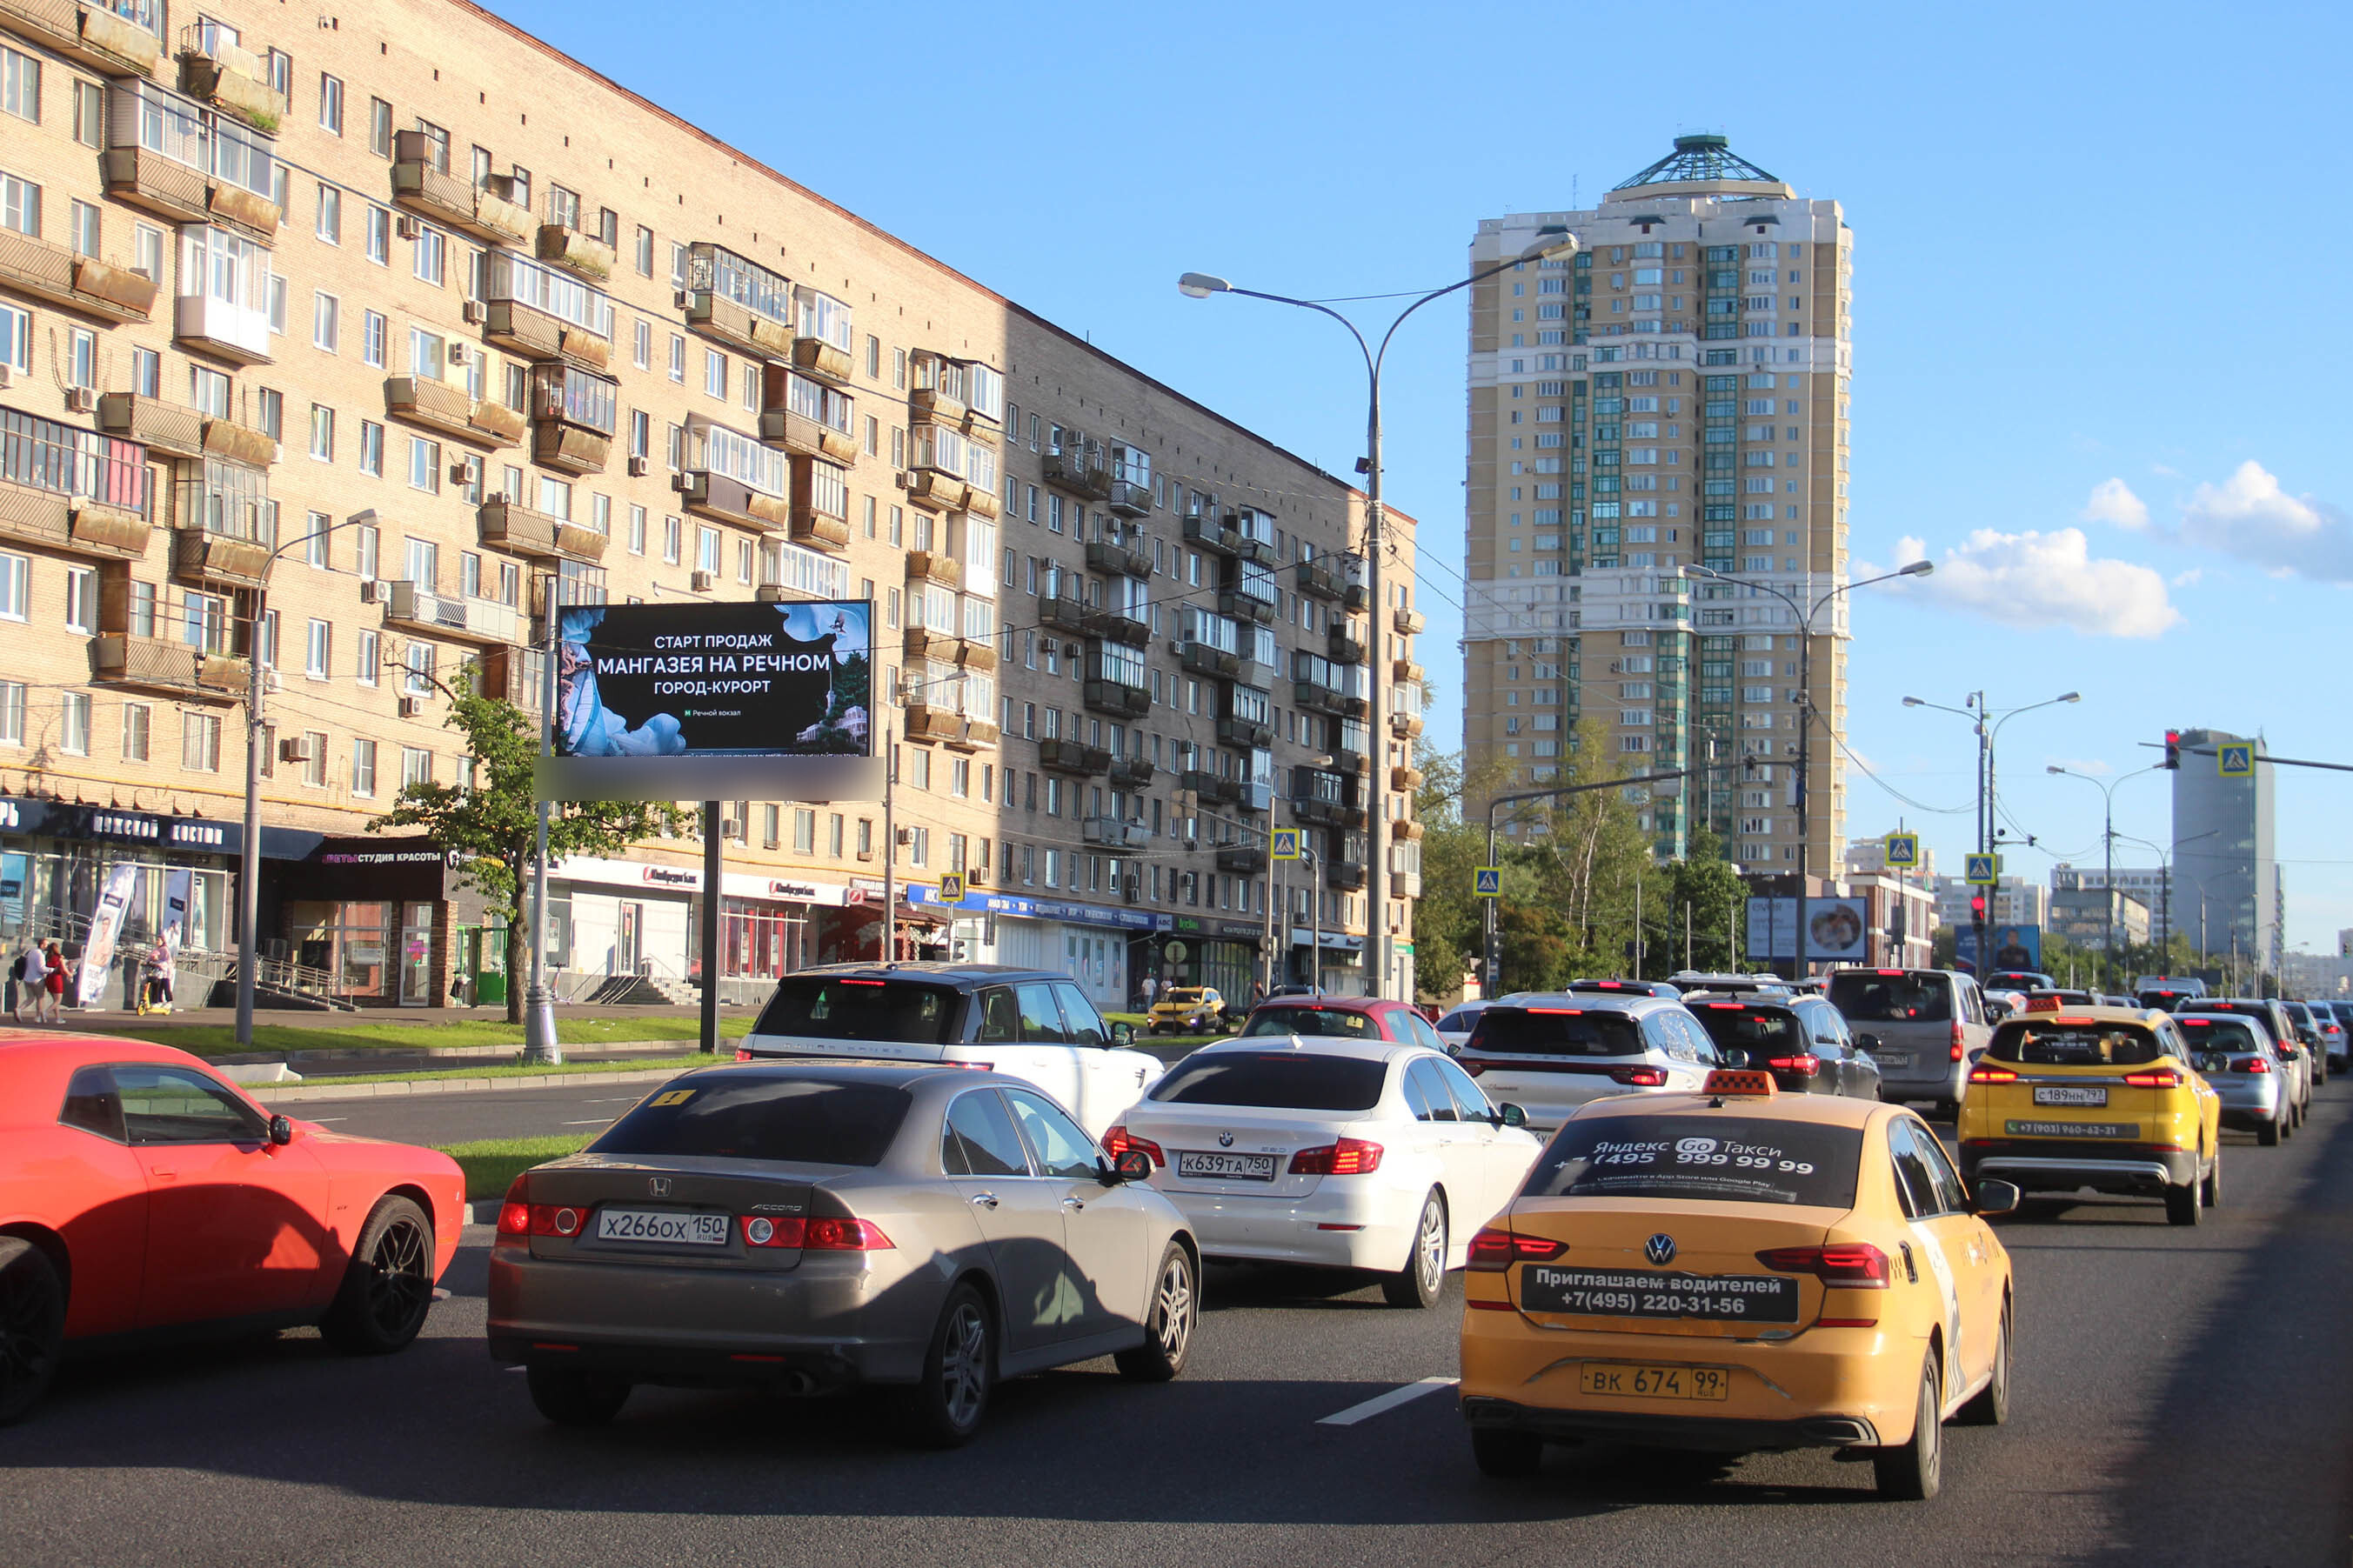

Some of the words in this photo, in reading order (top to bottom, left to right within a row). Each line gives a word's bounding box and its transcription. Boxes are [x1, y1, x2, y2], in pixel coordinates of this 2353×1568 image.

[654, 636, 702, 649] СТАРТ
[705, 634, 773, 650] ПРОДАЖ
[598, 656, 704, 675] МАНГАЗЕЯ
[709, 656, 737, 673] НА
[743, 654, 831, 672] РЕЧНОМ
[654, 680, 771, 696] ГОРОД-КУРОРТ
[358, 853, 395, 864] СТУДИЯ
[397, 851, 441, 862] КРАСОТЫ
[1594, 1141, 1669, 1154] Яндекс
[1679, 1138, 1712, 1152] Go
[1723, 1140, 1781, 1158] Такси
[1186, 1155, 1243, 1172] К639ТА
[1247, 1157, 1269, 1170] 750
[1675, 1152, 1728, 1165] 999
[1735, 1155, 1771, 1169] 99
[1778, 1159, 1814, 1175] 99
[605, 1215, 687, 1239] Х266ОХ
[692, 1217, 722, 1233] 150
[1536, 1269, 1664, 1289] Приглашаем
[1670, 1278, 1781, 1294] водителей
[1561, 1291, 1636, 1312] +7(495)
[1643, 1294, 1745, 1314] 220-31-56
[1593, 1371, 1621, 1391] ВК
[1634, 1370, 1680, 1394] 674
[1695, 1371, 1719, 1390] 99
